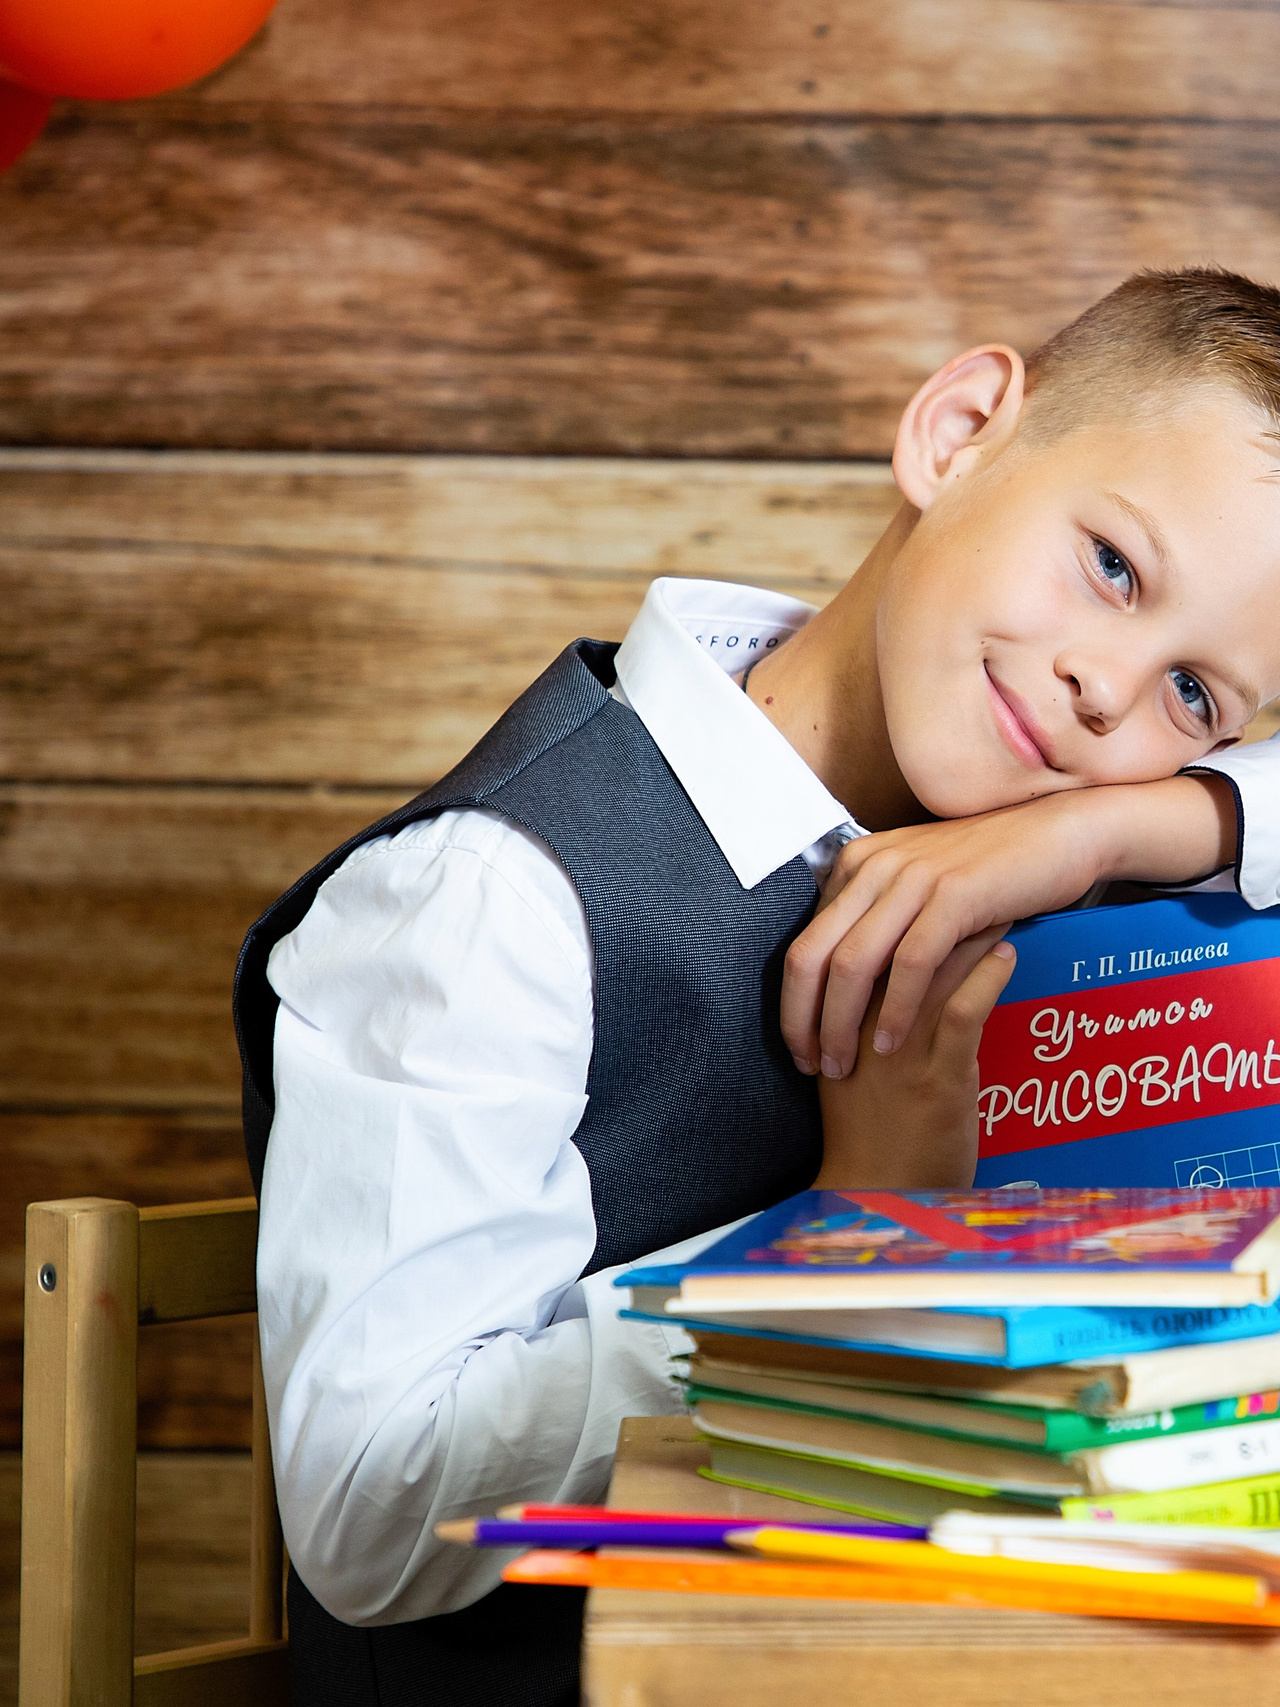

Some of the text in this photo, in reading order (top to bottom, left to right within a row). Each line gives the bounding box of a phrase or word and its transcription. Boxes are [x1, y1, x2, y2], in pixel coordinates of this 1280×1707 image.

[1072, 941, 1230, 982] Г. П. Шалаева
[1030, 997, 1214, 1062] Учимся
